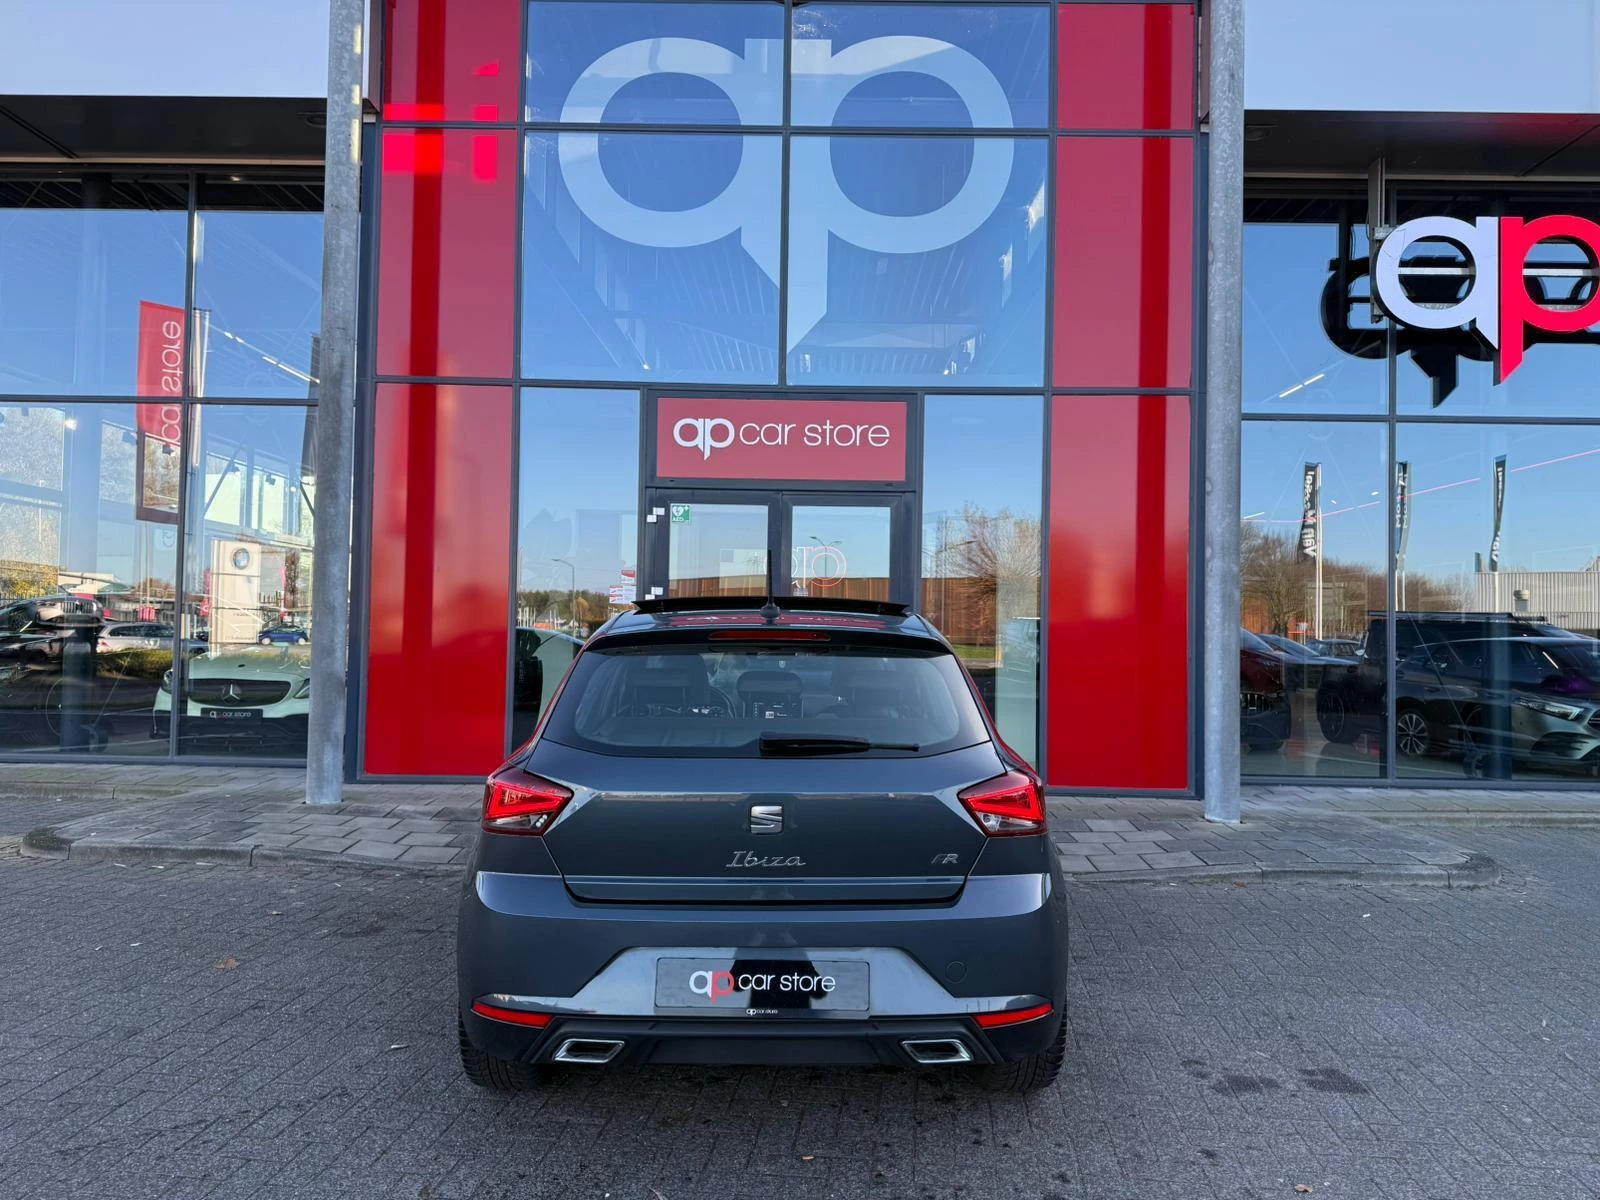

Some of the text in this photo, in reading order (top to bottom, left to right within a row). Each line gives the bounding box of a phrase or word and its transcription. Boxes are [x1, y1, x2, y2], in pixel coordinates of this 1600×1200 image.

[673, 418, 890, 461] ap car store
[726, 851, 806, 867] Ibiza
[689, 970, 836, 1004] ap car store
